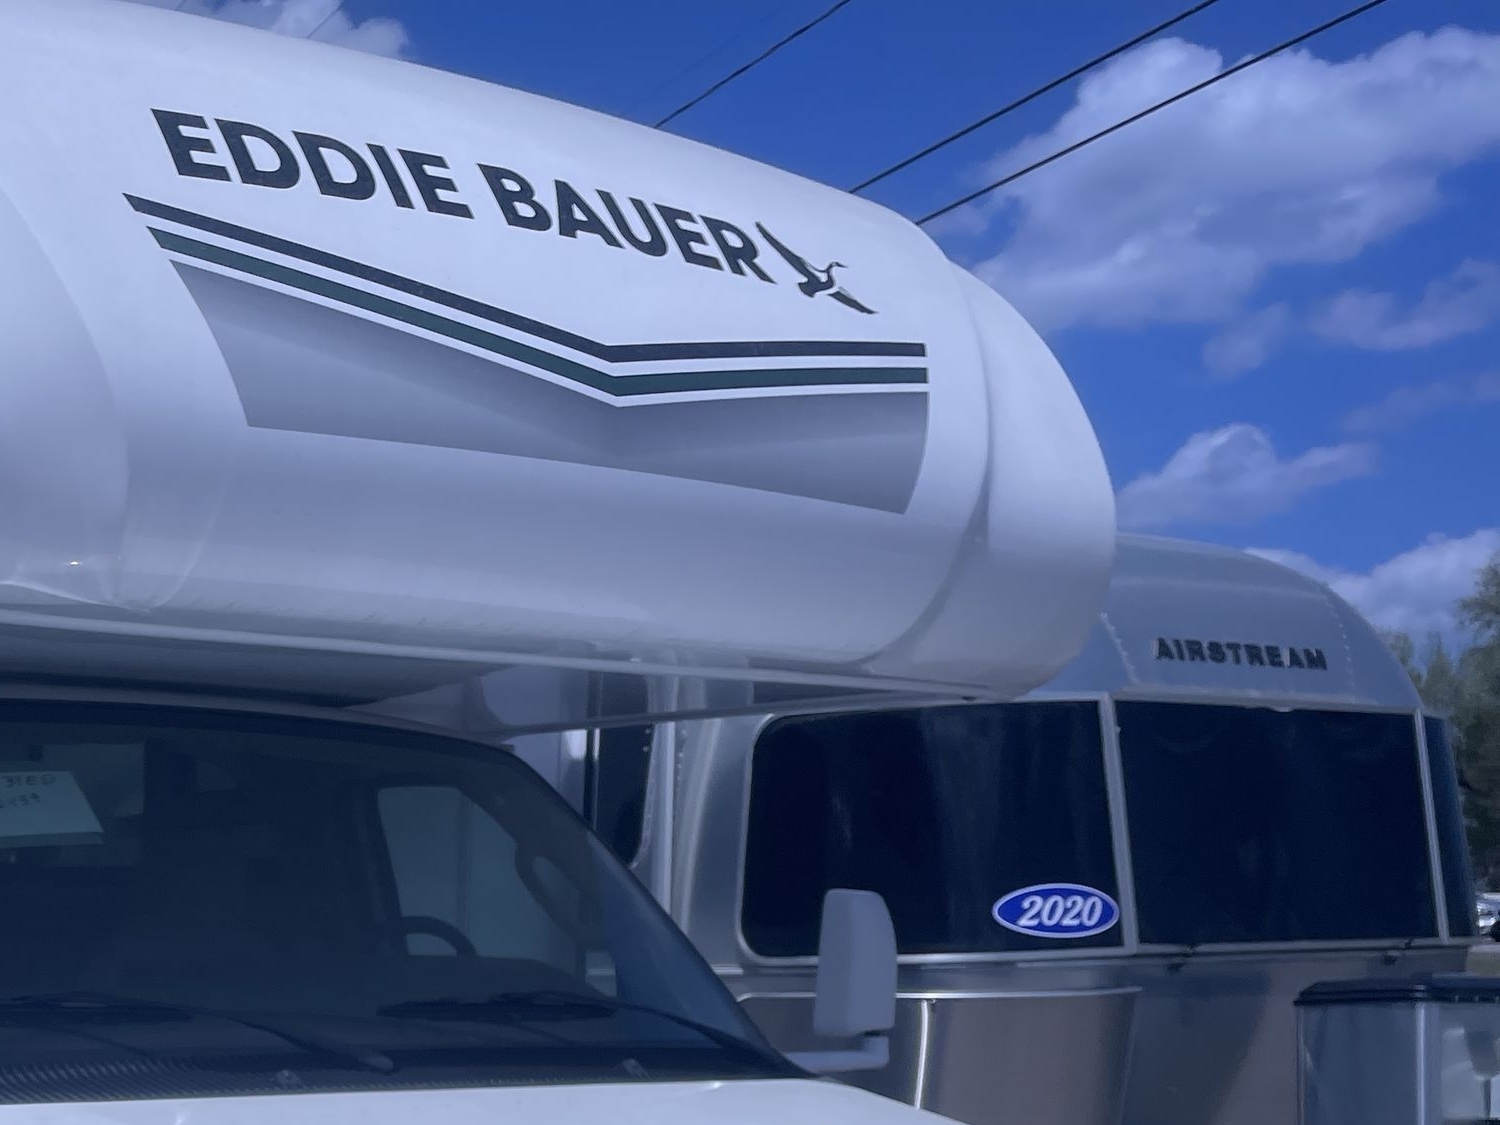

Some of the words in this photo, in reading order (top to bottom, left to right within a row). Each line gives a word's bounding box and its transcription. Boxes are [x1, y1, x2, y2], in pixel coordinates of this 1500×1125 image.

[150, 107, 475, 220] EDDIE
[476, 162, 778, 285] BAUER
[1155, 636, 1329, 672] AIRSTREAM
[1016, 894, 1103, 927] 2020
